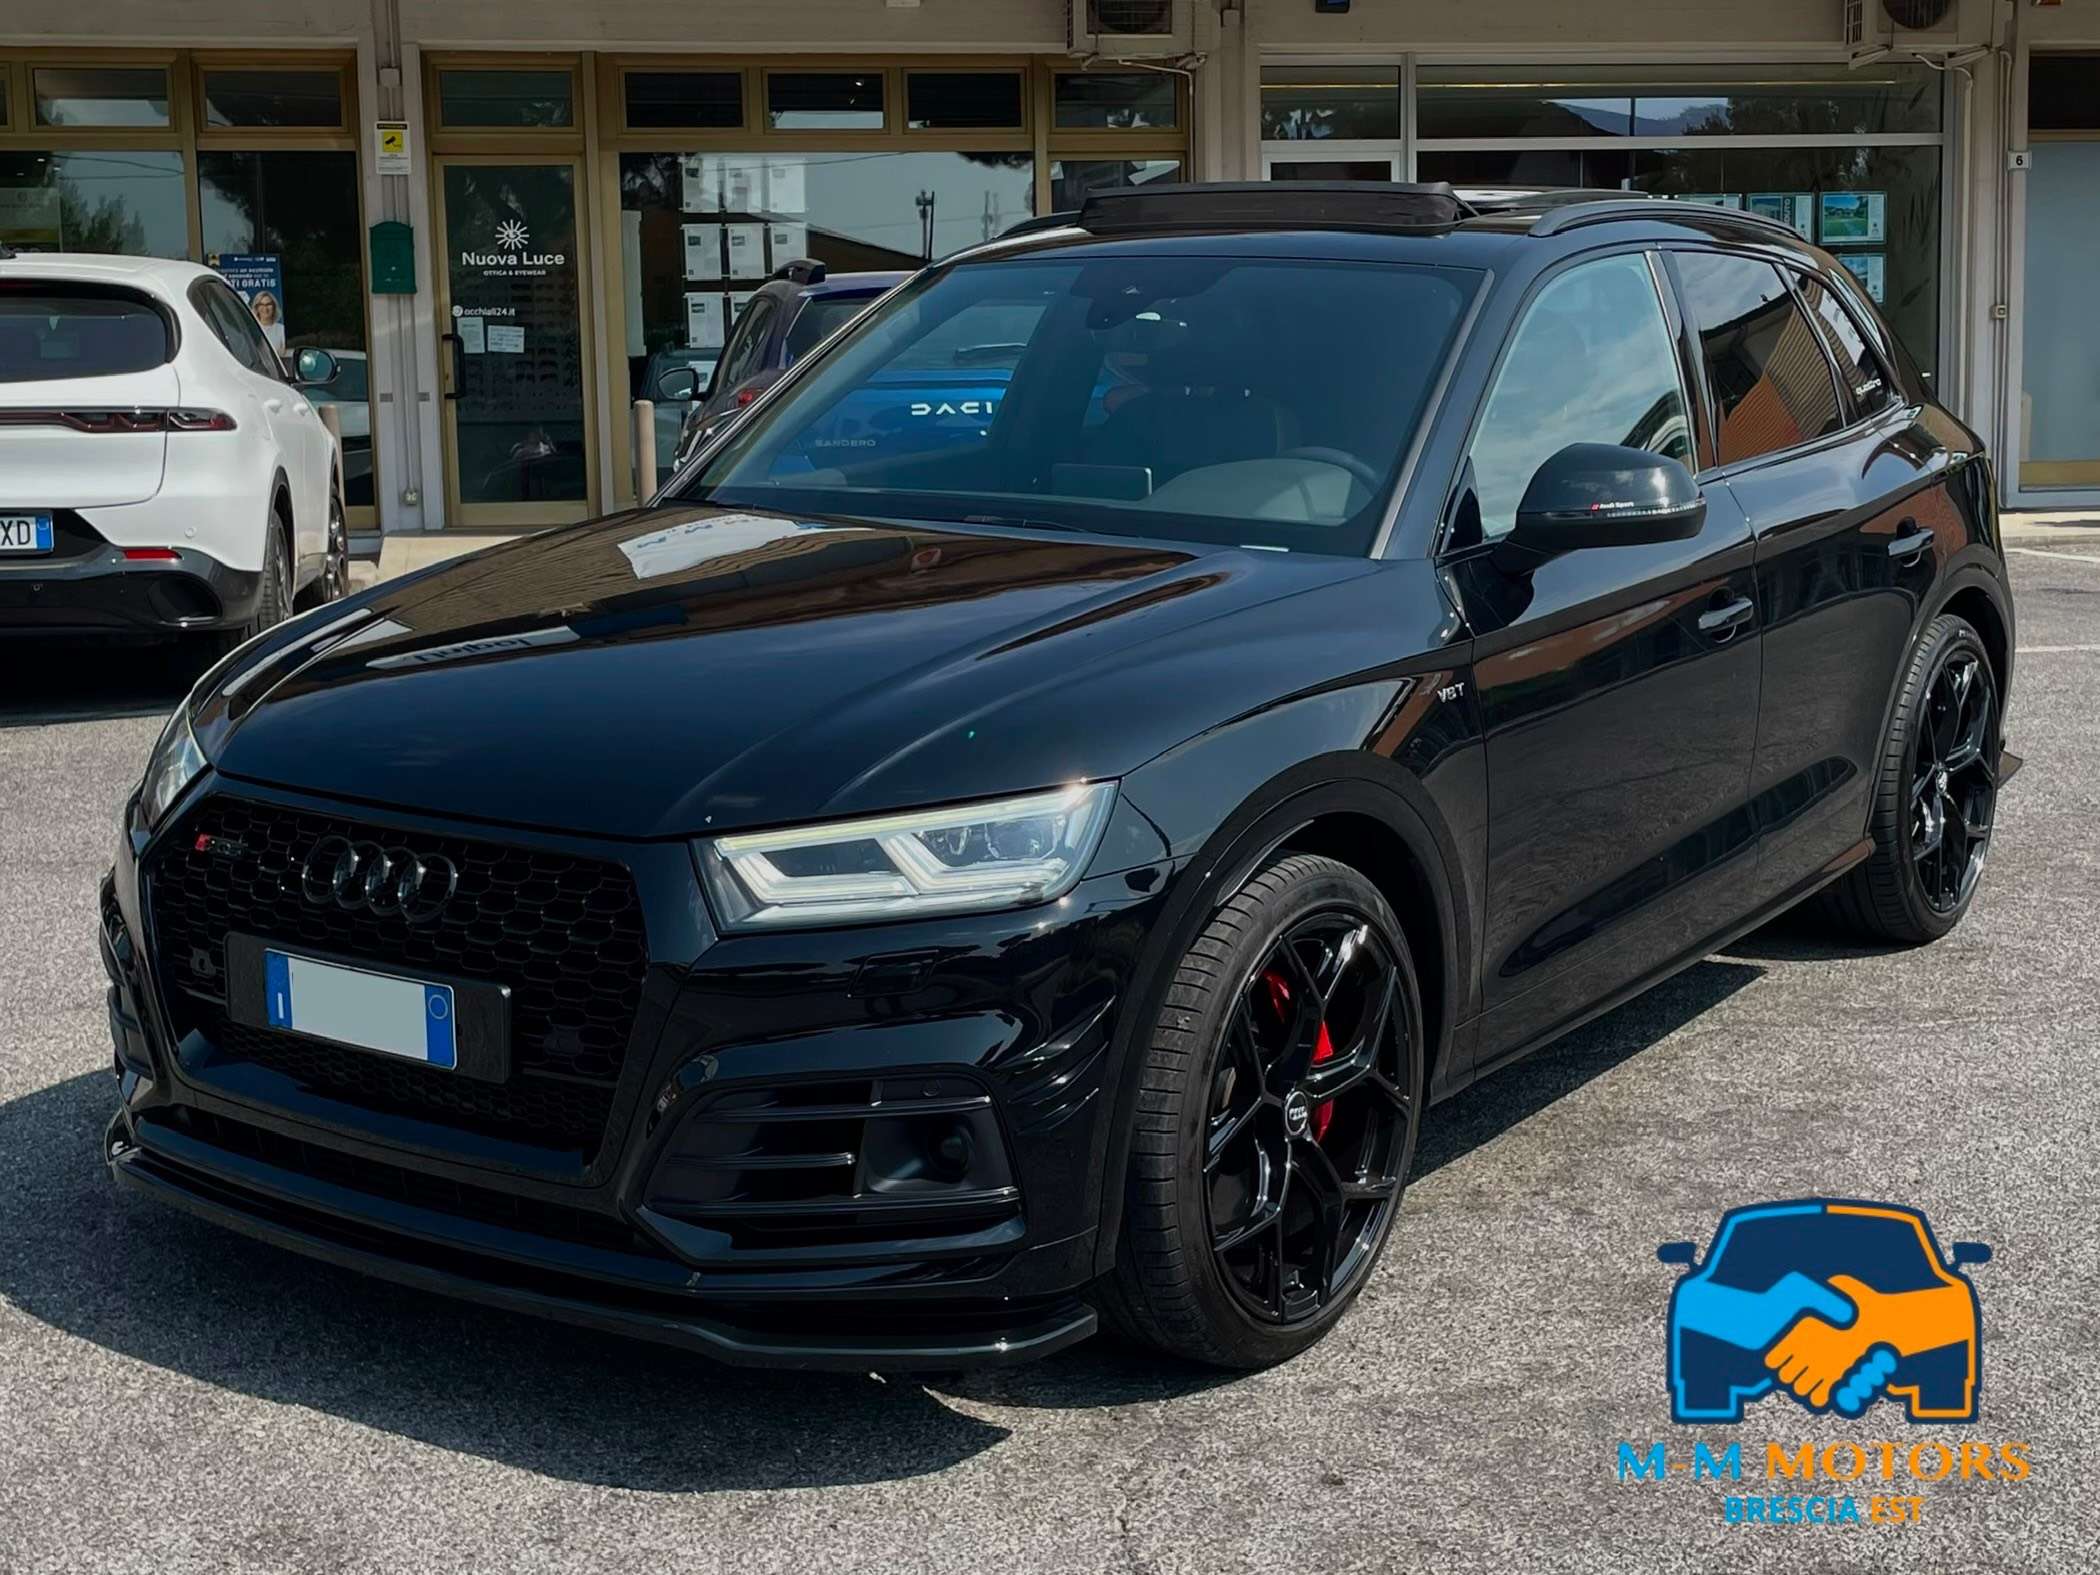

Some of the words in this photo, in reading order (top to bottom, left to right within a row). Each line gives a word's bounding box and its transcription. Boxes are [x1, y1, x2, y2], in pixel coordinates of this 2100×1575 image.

[2015, 154, 2024, 166] 6
[462, 251, 518, 266] Nuova
[522, 251, 566, 266] Luce
[242, 279, 276, 288] GRATIS
[910, 401, 994, 416] DACI
[814, 438, 877, 447] SANDERO
